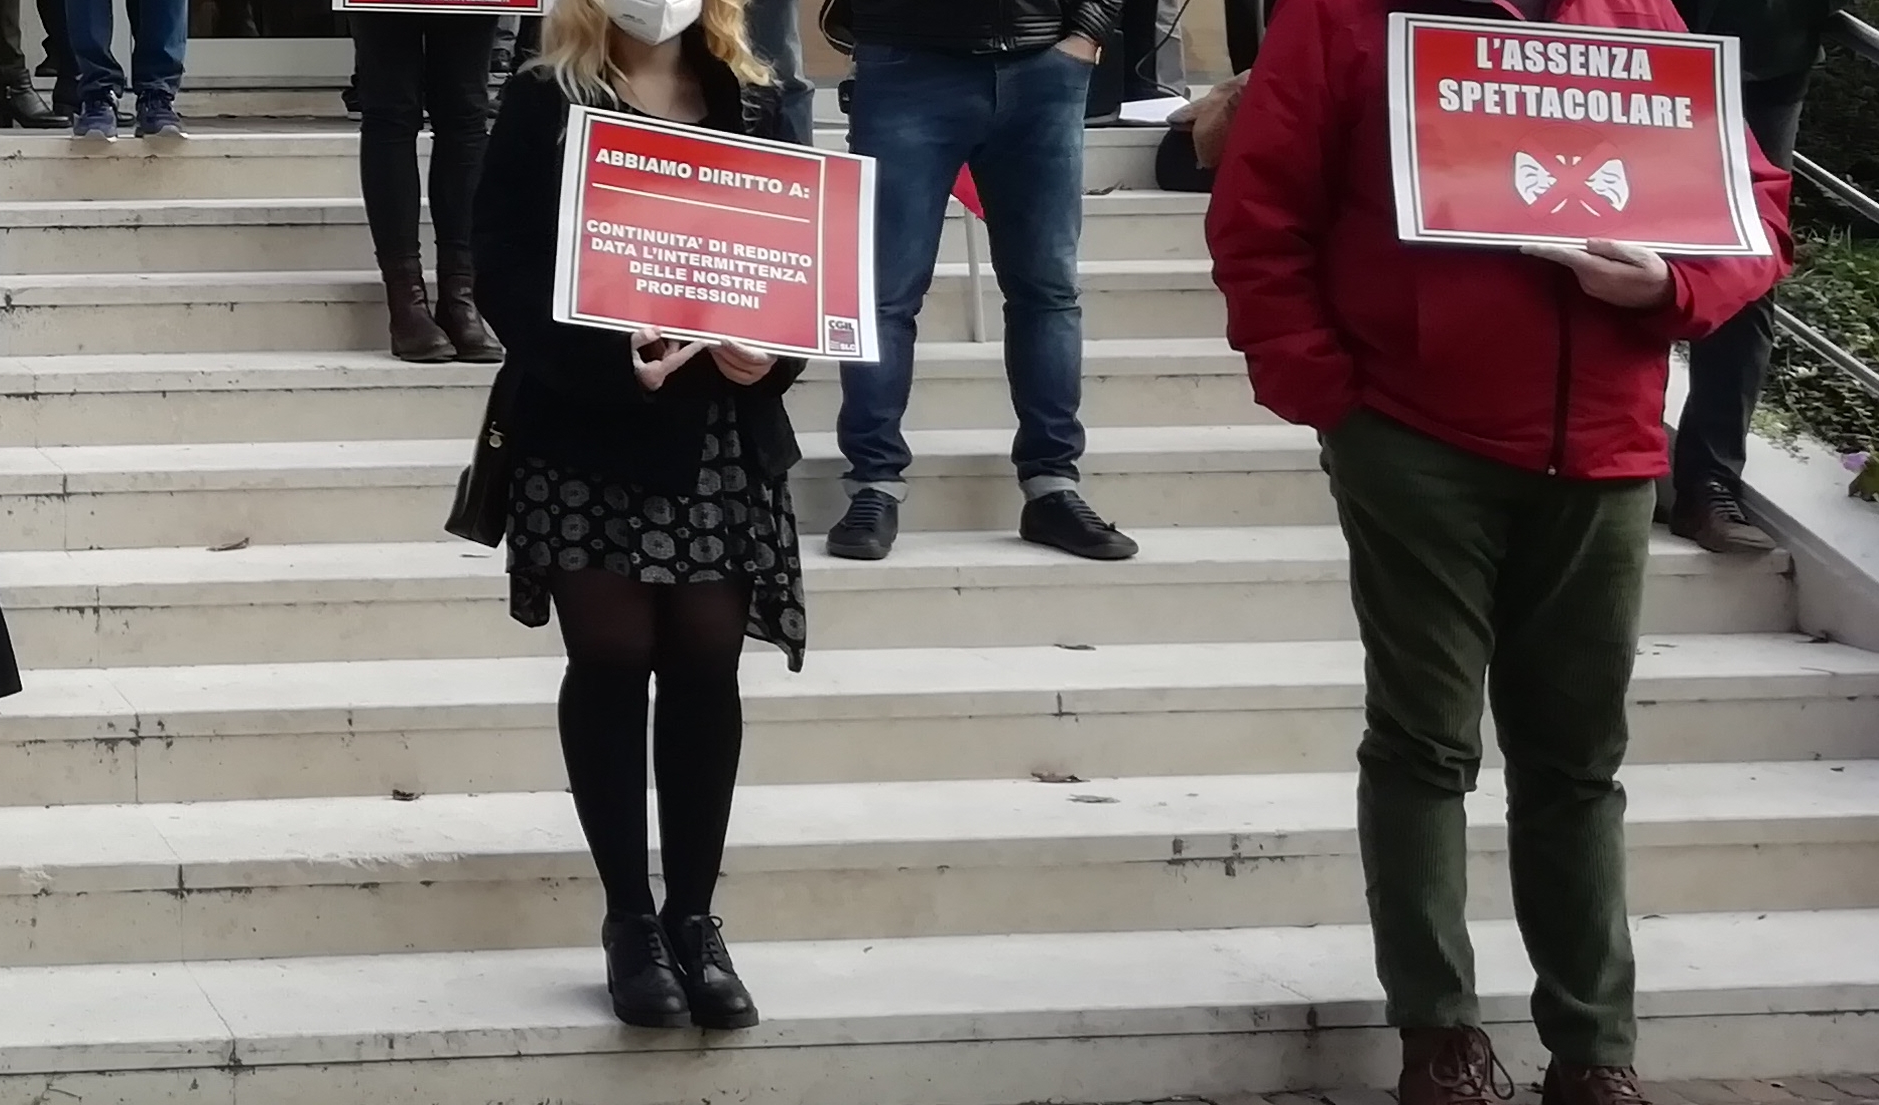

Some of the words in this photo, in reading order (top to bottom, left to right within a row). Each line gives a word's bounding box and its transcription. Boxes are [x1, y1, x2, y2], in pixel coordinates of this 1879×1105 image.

[1476, 36, 1653, 81] L'ASSENZA
[1438, 78, 1694, 129] SPETTACOLARE
[595, 148, 692, 179] ABBIAMO
[698, 166, 782, 194] DIRITTO
[788, 182, 810, 199] A:
[586, 219, 704, 249] CONTINUITA'
[708, 239, 727, 253] DI
[733, 243, 813, 268] REDDITO
[591, 237, 637, 257] DATA
[642, 246, 808, 284] L'INTERMITTENZA
[629, 260, 687, 281] DELLE
[692, 266, 767, 294] NOSTRE
[636, 278, 760, 309] PROFESSIONI
[828, 319, 853, 330] CGIL
